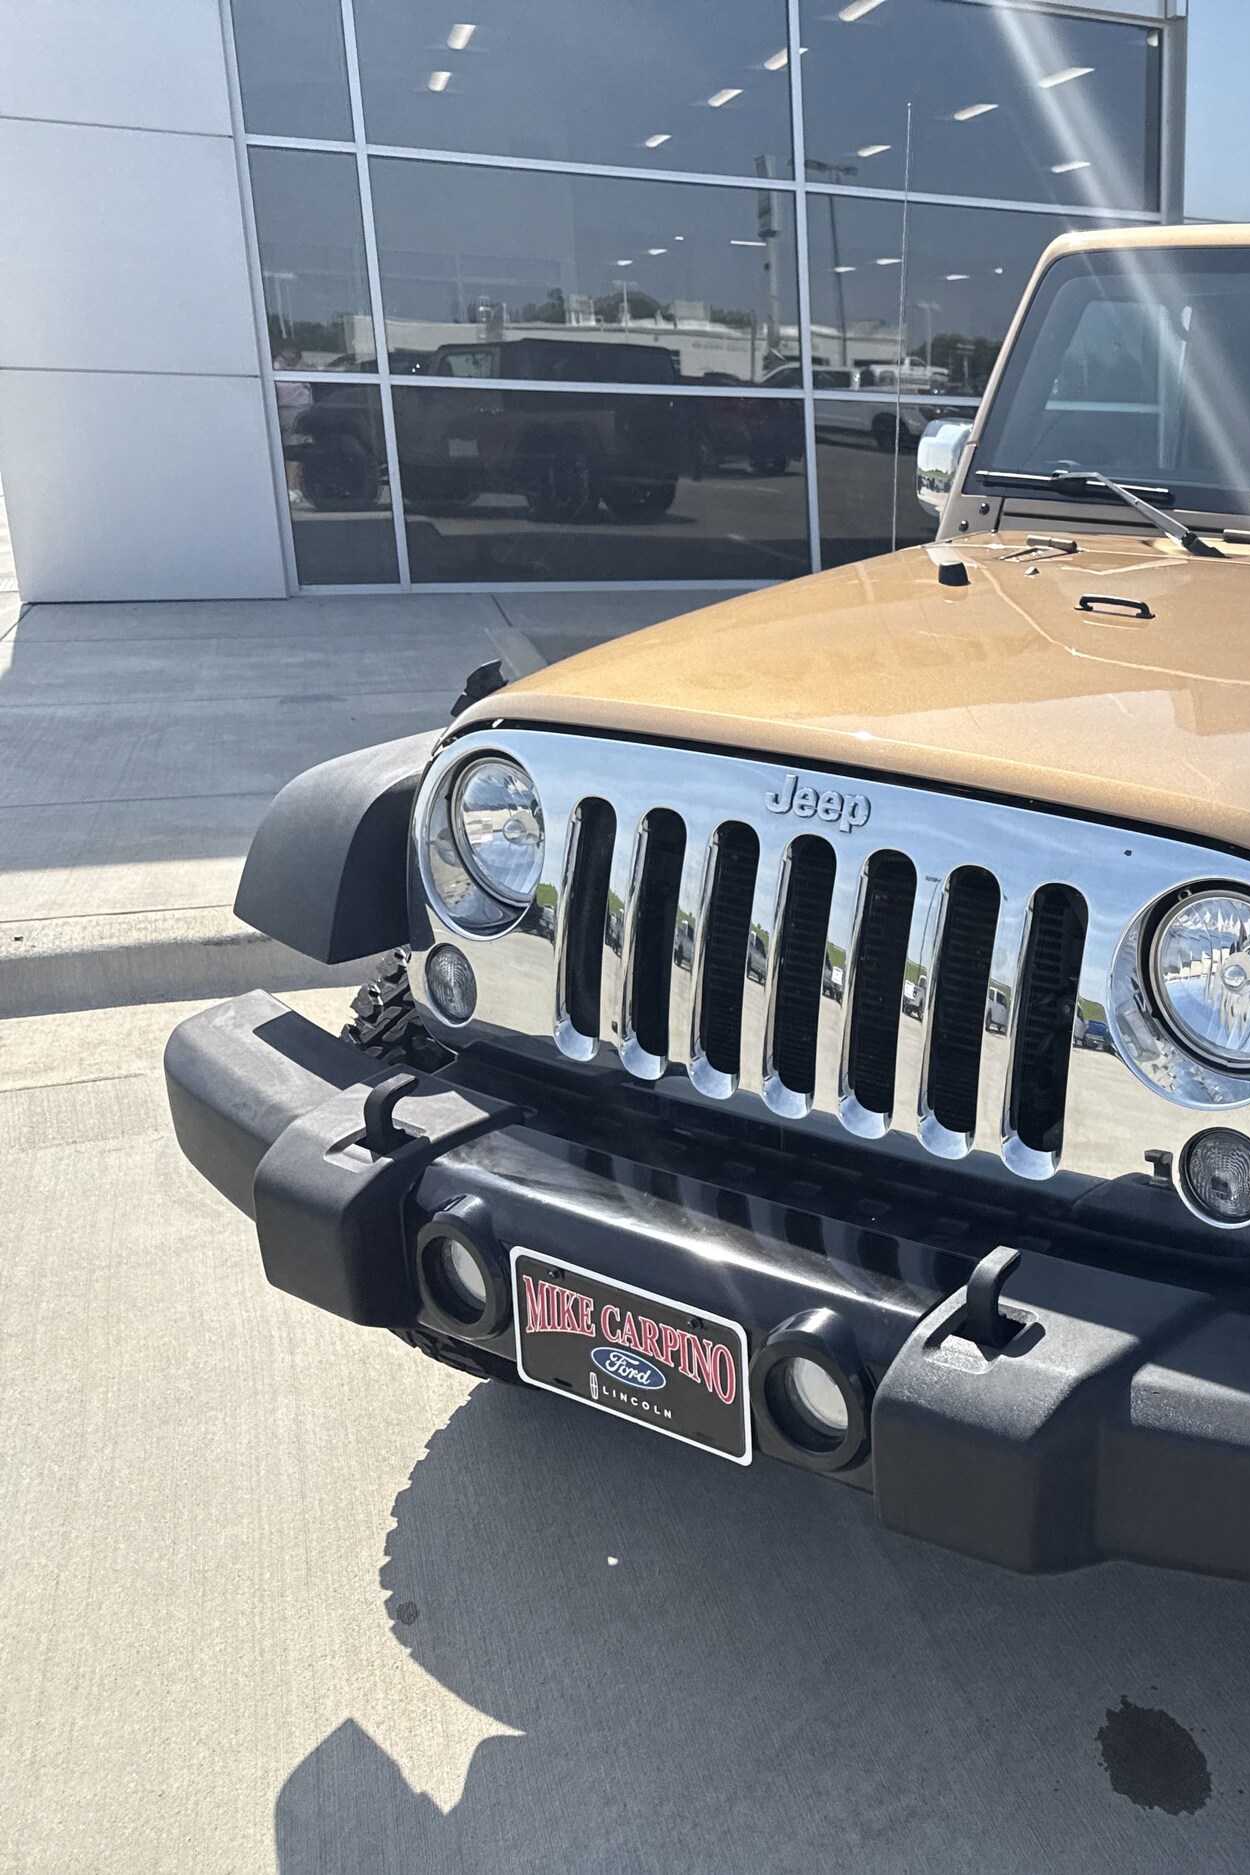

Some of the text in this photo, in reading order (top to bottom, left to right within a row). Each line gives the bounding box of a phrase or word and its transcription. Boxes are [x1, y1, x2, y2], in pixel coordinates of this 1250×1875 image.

[765, 774, 871, 834] Jeep
[522, 1275, 736, 1405] MIKE CARPINO
[604, 1351, 651, 1385] Ford
[602, 1385, 672, 1419] LINCOLN
